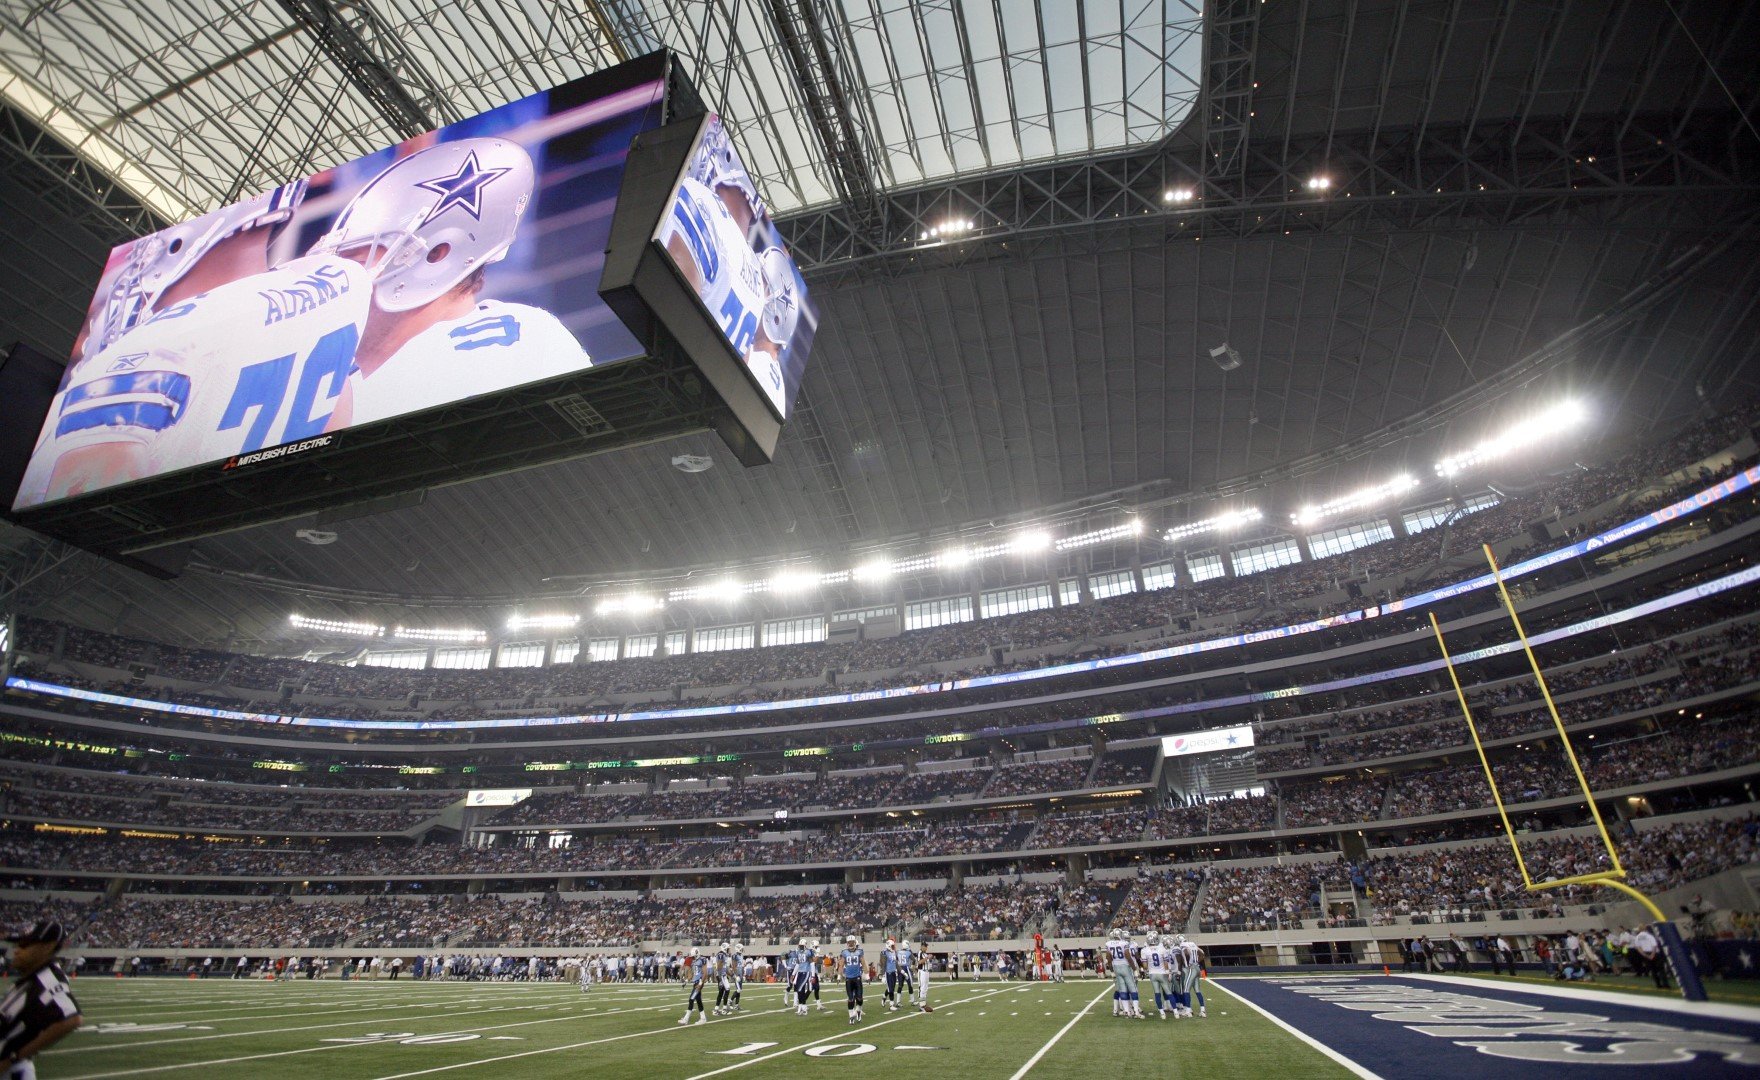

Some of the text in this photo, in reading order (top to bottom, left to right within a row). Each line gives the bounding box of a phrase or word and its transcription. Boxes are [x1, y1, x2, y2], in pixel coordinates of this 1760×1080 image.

[258, 264, 350, 327] ADAMS
[237, 435, 333, 467] MITSUBISHI ELECTRIC
[1695, 480, 1738, 508] OFF
[1603, 521, 1648, 544] Albertsons
[1433, 587, 1457, 600] When
[1456, 583, 1472, 594] you
[1472, 577, 1492, 589] wear
[1244, 628, 1285, 644] Game
[1082, 714, 1121, 726] OWBOYS
[253, 761, 294, 771] COWBOYS
[846, 955, 859, 966] 93
[1109, 946, 1124, 960] 76
[1151, 953, 1160, 967] 9
